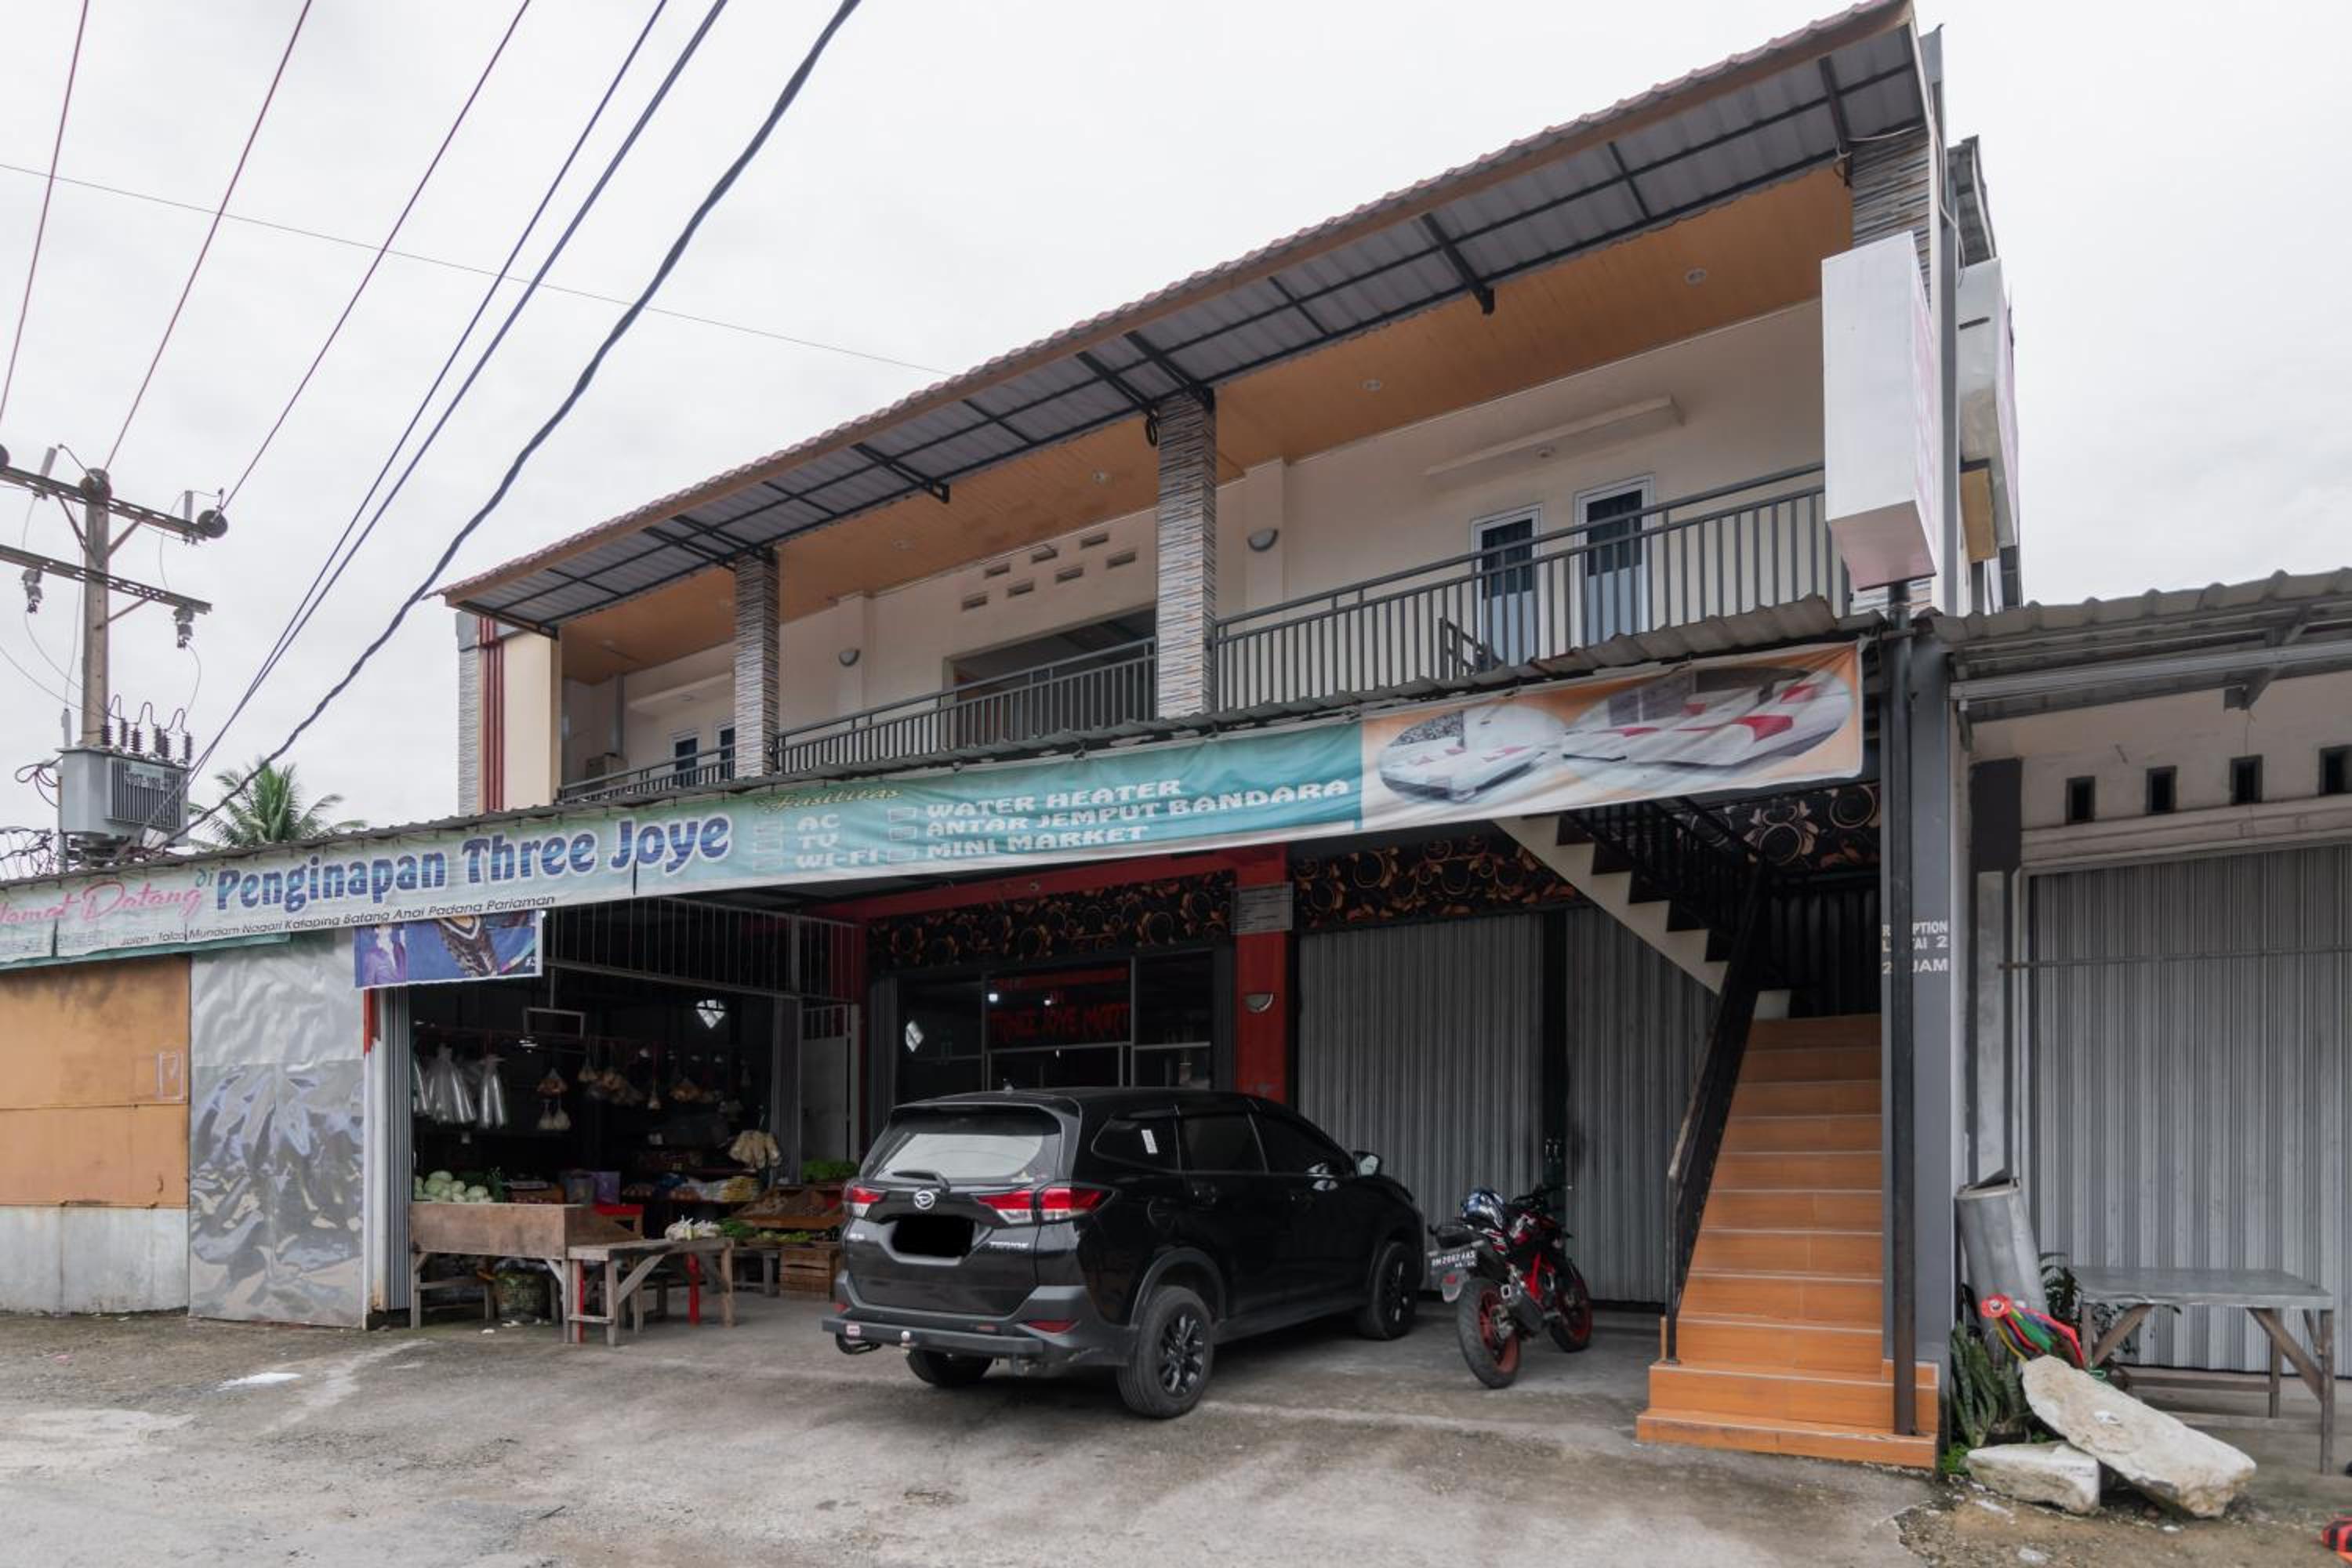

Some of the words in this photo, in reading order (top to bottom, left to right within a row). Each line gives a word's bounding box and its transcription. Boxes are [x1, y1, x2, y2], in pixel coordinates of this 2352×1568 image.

[927, 796, 1036, 818] WATER
[1046, 780, 1181, 808] HEATER
[927, 817, 1029, 837] ANTAR
[1036, 802, 1160, 828] JEMPUT
[1168, 779, 1349, 815] BANDARA
[797, 814, 840, 832] AC
[797, 833, 840, 849] TV
[927, 839, 996, 859] MINI
[1007, 826, 1149, 851] MARKET
[82, 877, 201, 923] Datang
[217, 851, 446, 913] Penginapan
[462, 833, 595, 884] Three
[611, 816, 729, 873] Joye
[796, 848, 879, 869] WI-FI
[242, 920, 282, 934] Nagari
[394, 908, 425, 920] Anai
[487, 895, 556, 910] Pariaman
[1882, 920, 1948, 936] RPTION
[1936, 935, 1948, 948] 2
